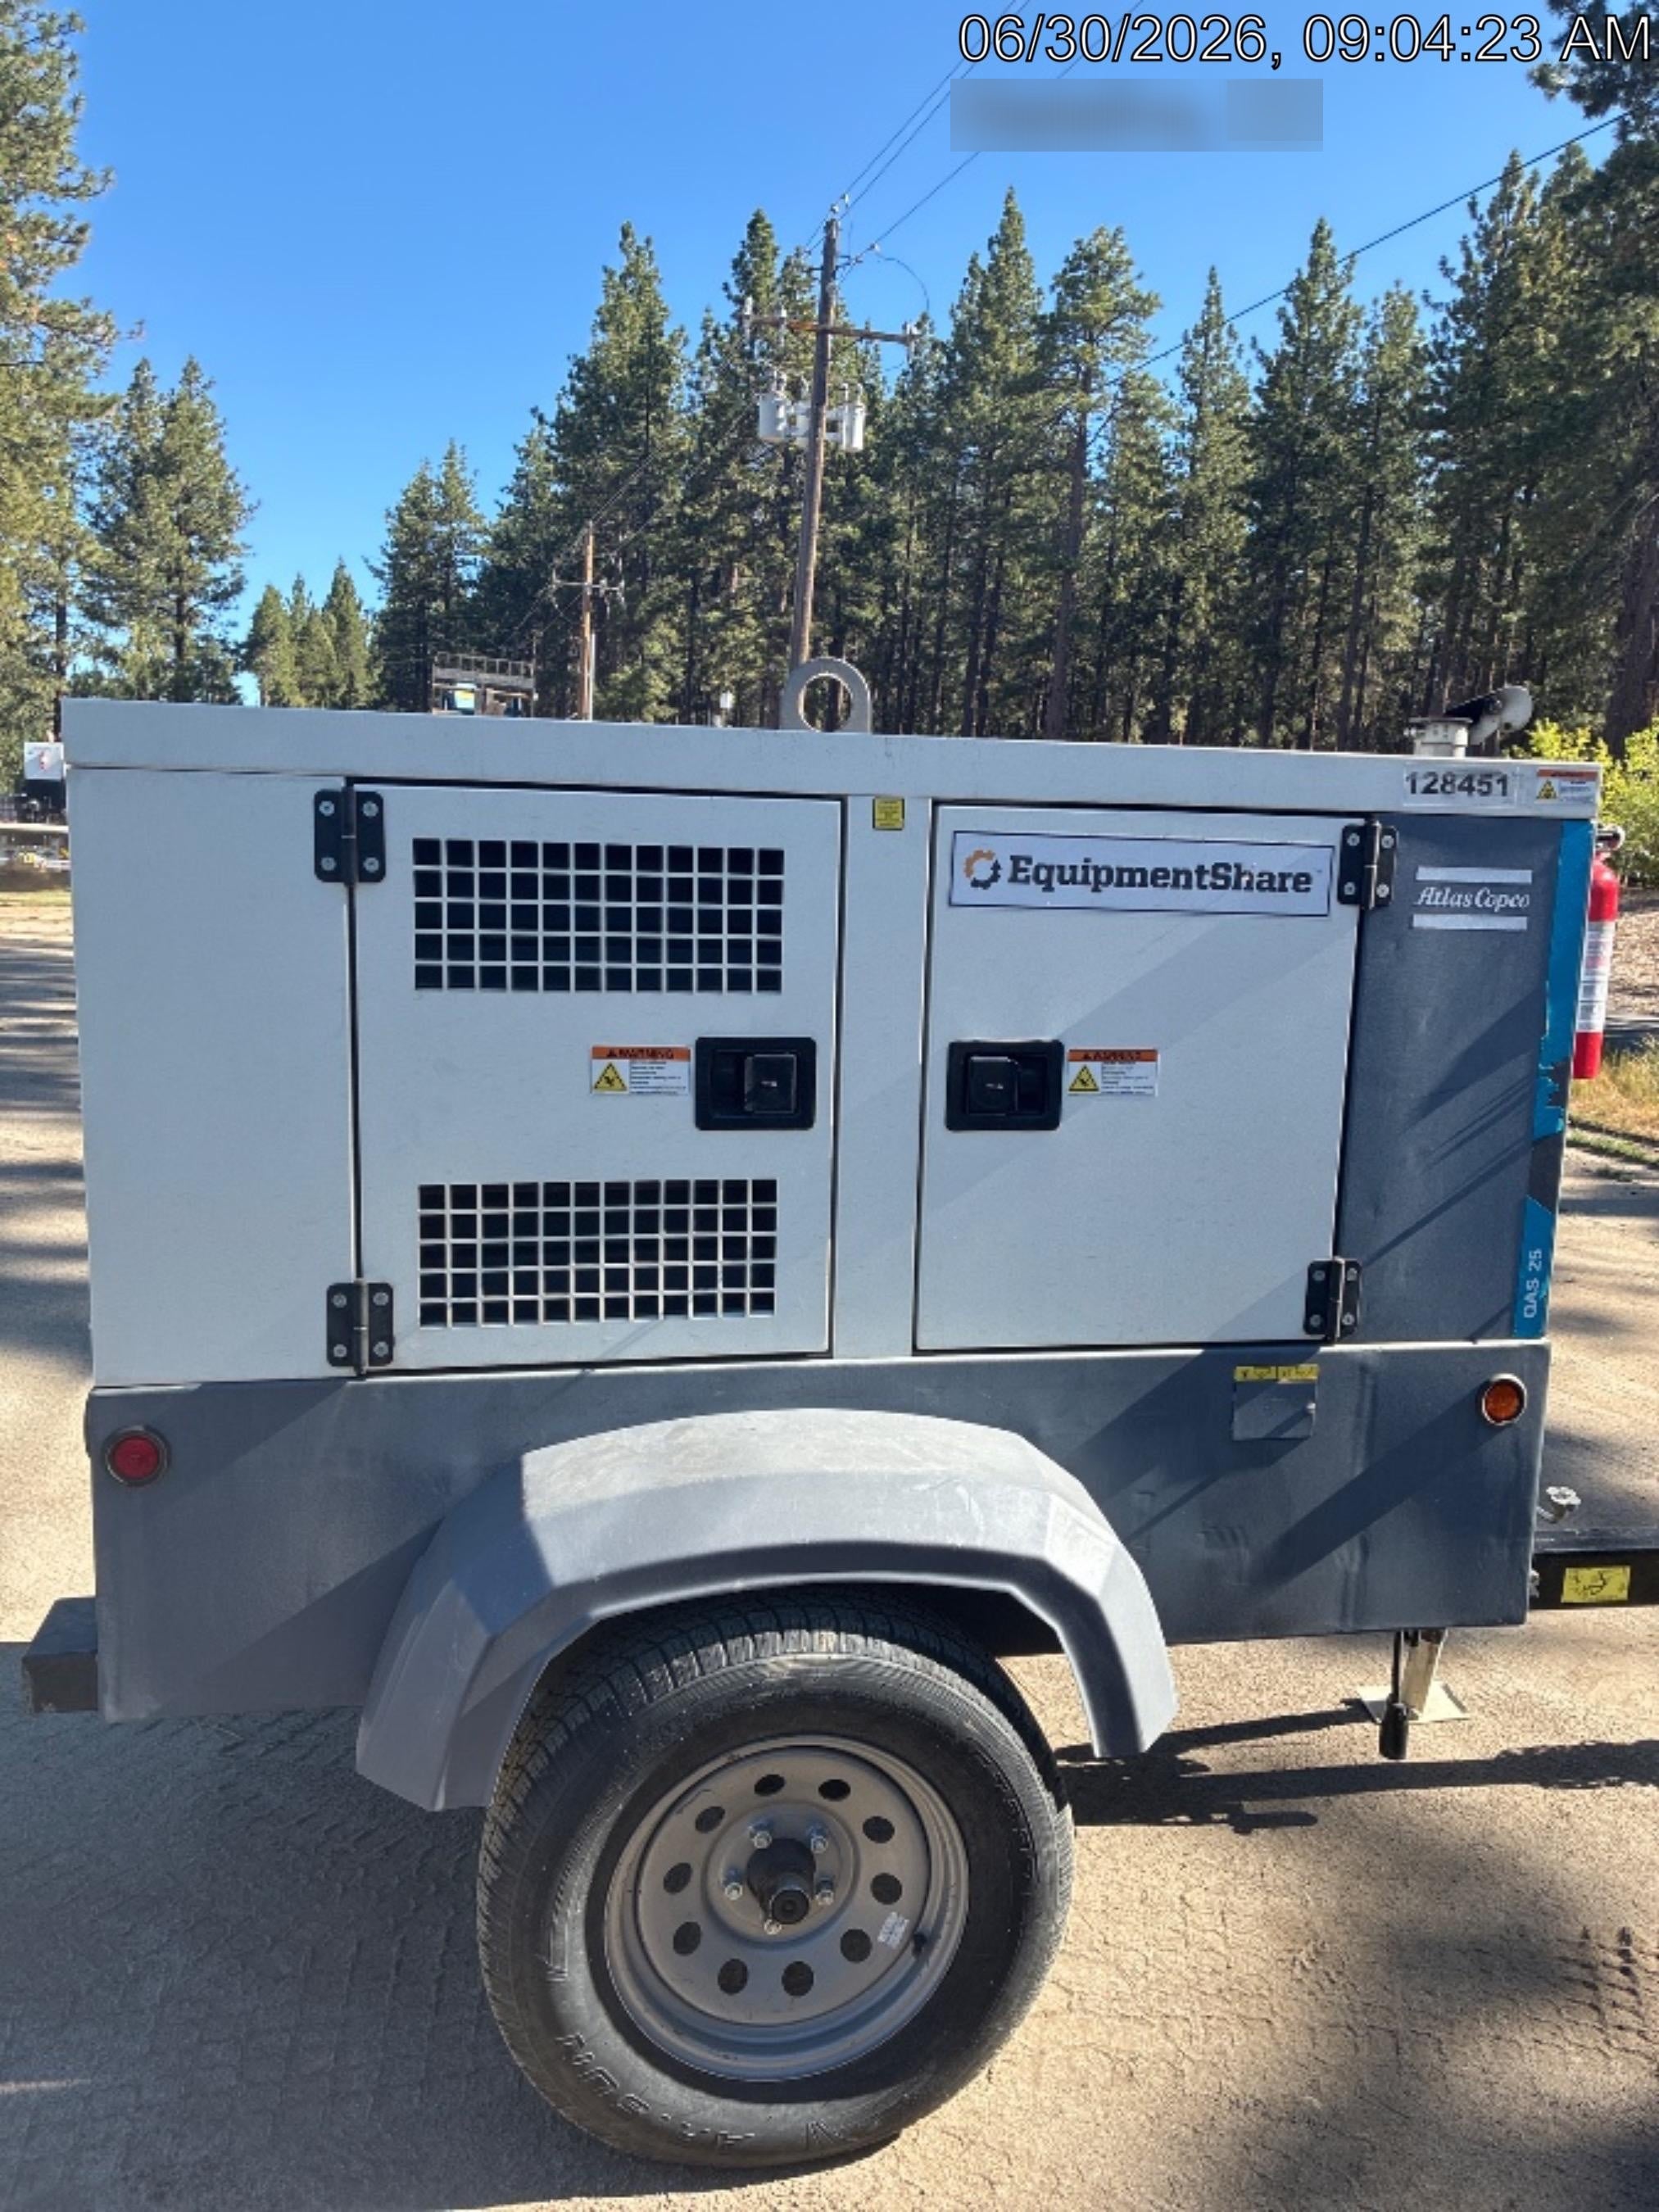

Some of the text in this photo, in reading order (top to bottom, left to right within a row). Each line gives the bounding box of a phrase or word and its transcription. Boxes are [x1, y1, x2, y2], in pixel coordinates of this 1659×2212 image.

[1406, 771, 1508, 796] 128451
[1007, 854, 1313, 893] EquipmentShare
[1416, 886, 1530, 913] Atlas Copco
